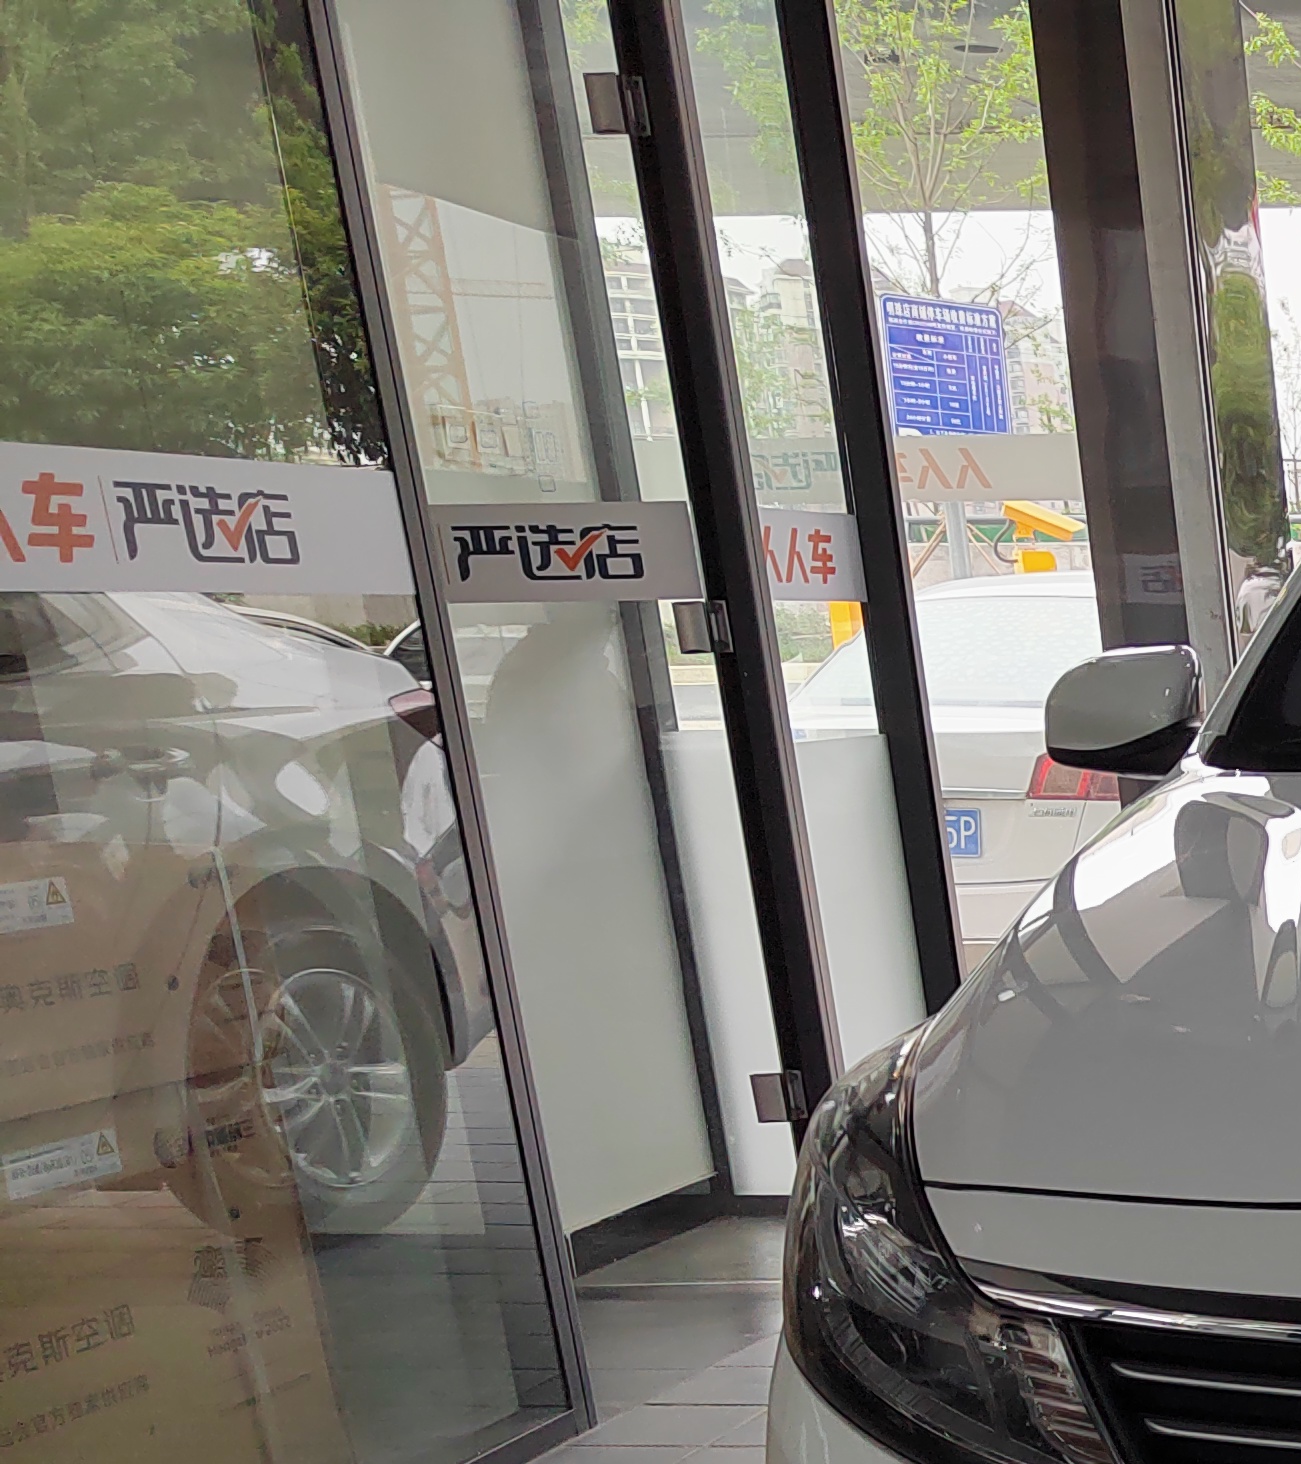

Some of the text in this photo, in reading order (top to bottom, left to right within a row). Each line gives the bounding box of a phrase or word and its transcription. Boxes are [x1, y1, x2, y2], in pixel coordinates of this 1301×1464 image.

[0, 472, 301, 565] 车 严选店
[451, 524, 645, 582] 严选店
[763, 525, 836, 584] 人人车
[0, 1303, 136, 1384] 克斯空调
